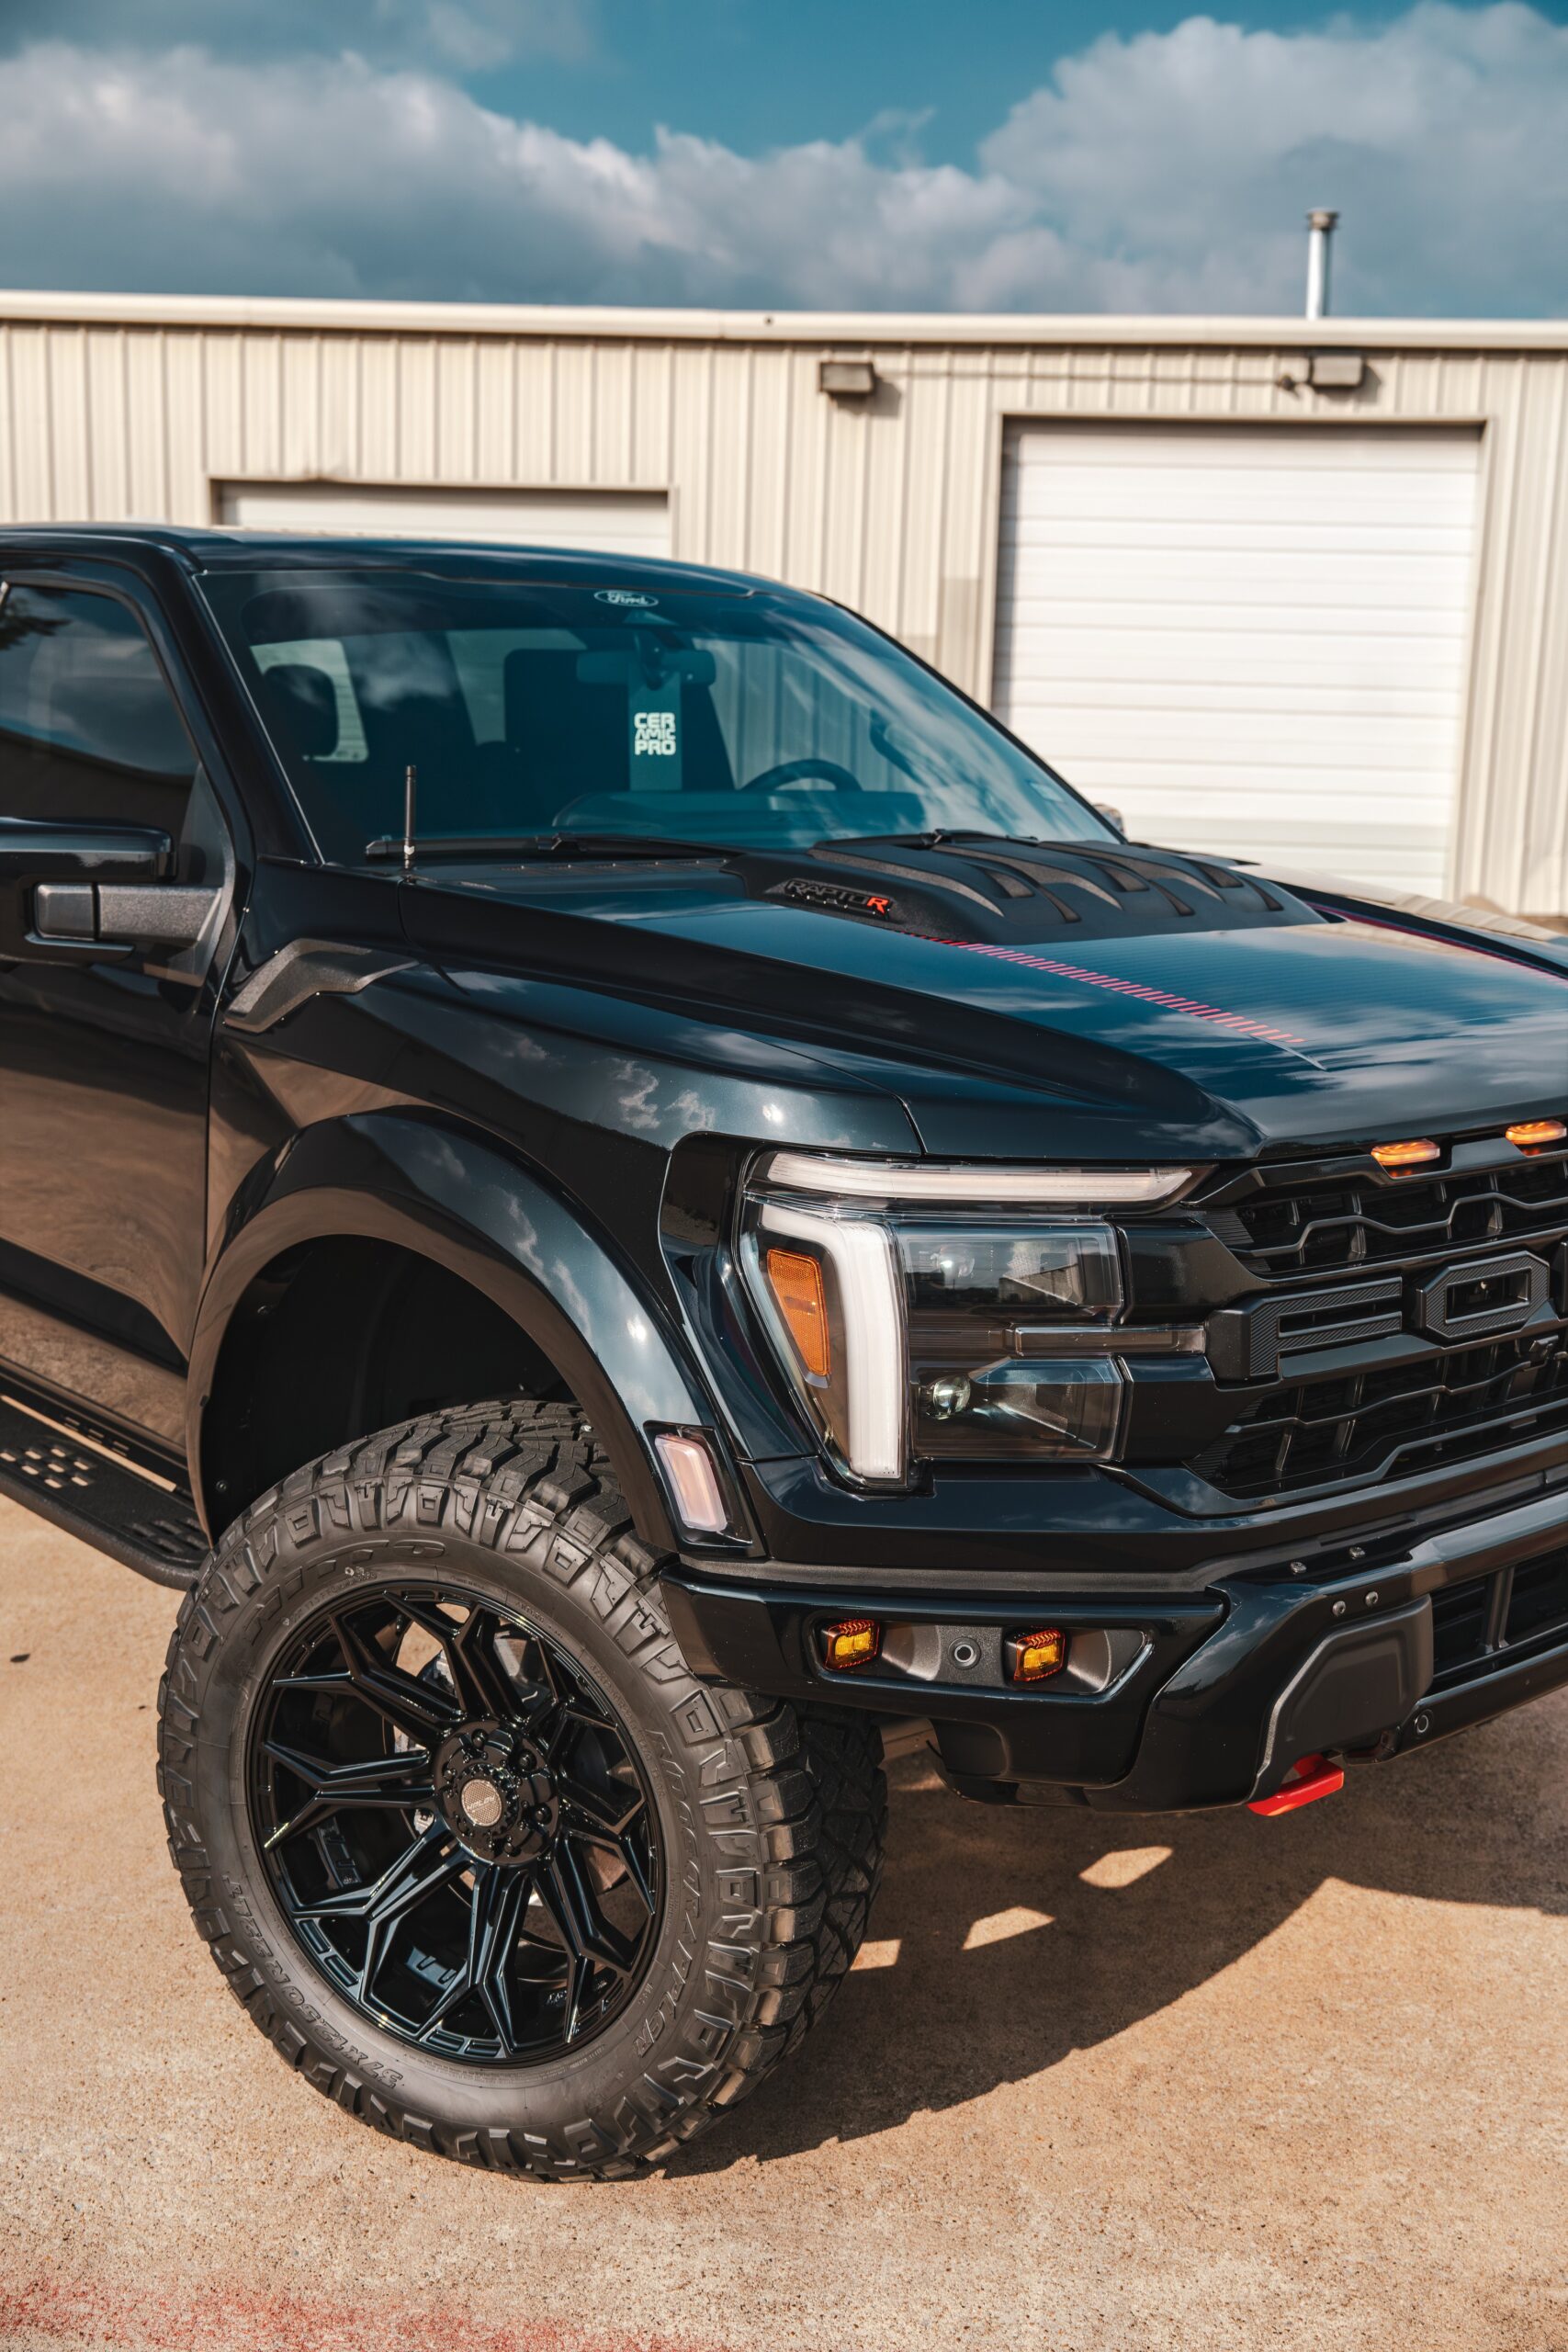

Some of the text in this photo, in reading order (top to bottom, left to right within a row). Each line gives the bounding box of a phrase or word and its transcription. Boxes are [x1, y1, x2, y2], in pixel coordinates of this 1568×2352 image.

[634, 712, 675, 729] CER
[635, 740, 676, 755] PRO
[785, 879, 890, 915] RAPTOR
[1248, 1248, 1568, 1377] FO
